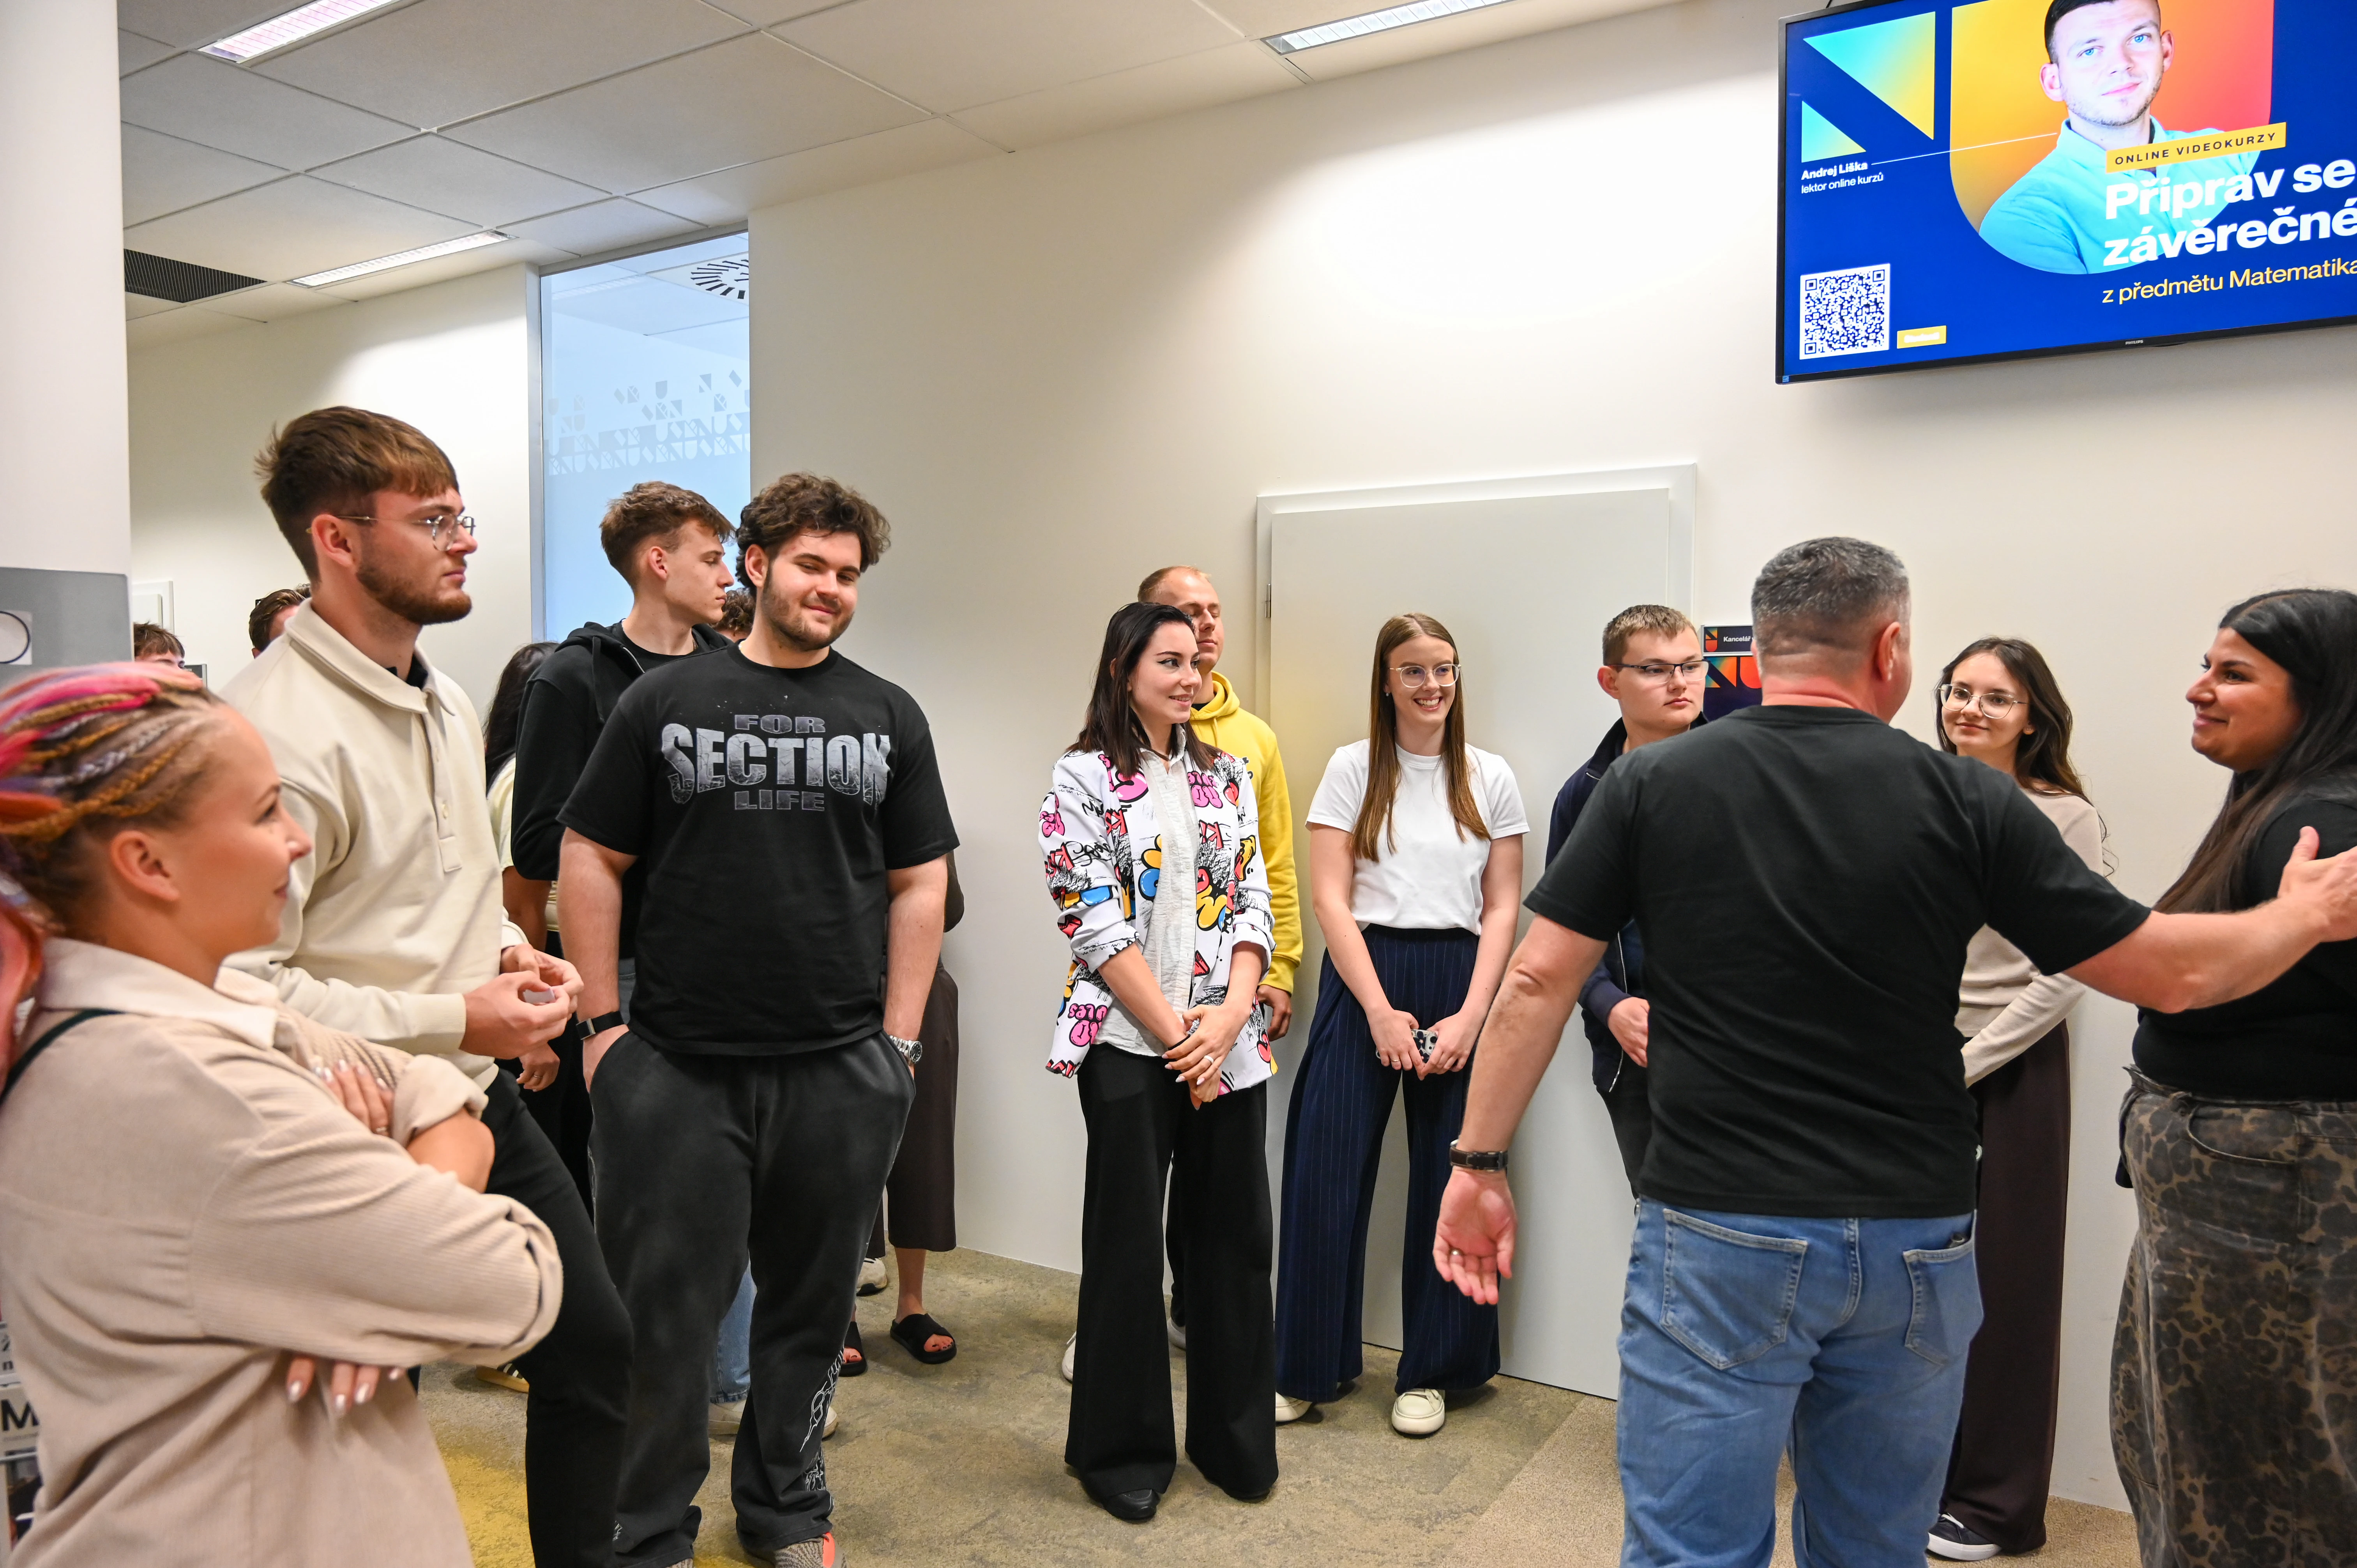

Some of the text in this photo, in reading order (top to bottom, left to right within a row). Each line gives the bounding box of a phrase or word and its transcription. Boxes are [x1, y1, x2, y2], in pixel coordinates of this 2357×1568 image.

[2115, 132, 2276, 165] ONLINE VIDEOKURZY
[1801, 162, 1868, 180] Andrej Liška
[1801, 172, 1884, 194] lektor online kurzů
[2105, 159, 2356, 220] Připrav se
[2103, 197, 2357, 266] závěrečné
[2102, 258, 2357, 305] z předmětu Matematika
[734, 714, 826, 734] FOR
[662, 723, 891, 810] SECTION
[734, 789, 825, 811] LIFE
